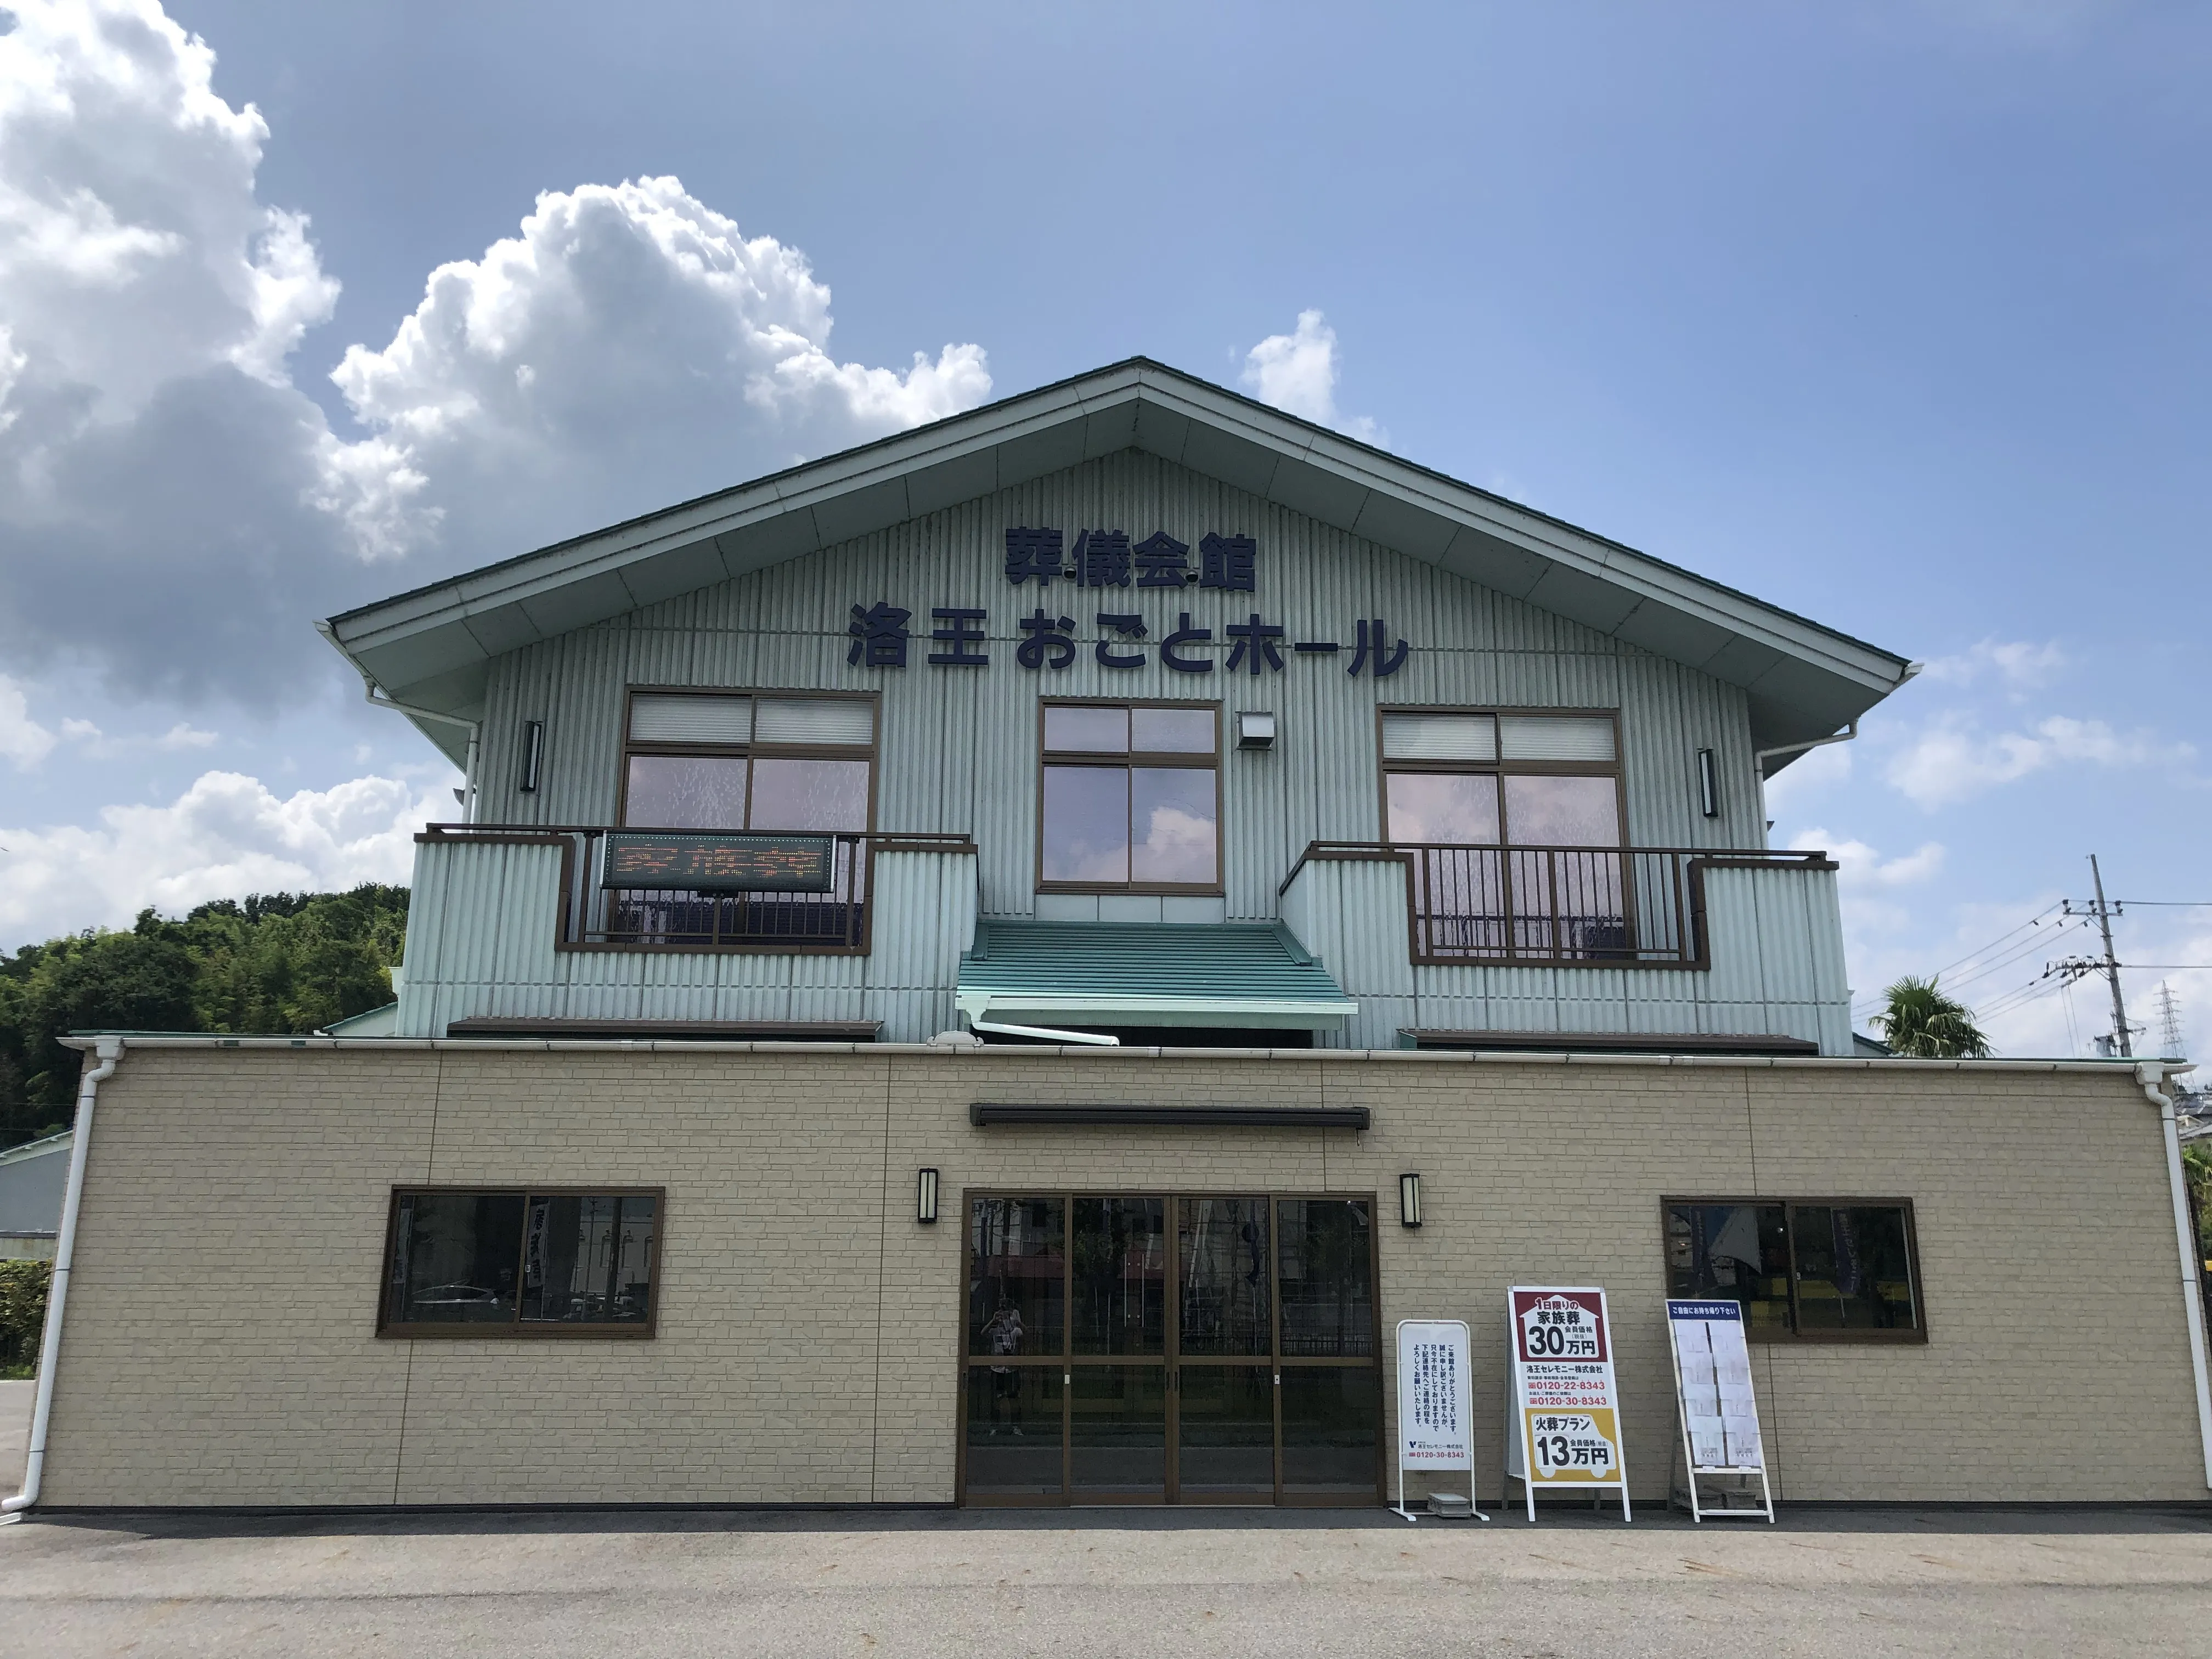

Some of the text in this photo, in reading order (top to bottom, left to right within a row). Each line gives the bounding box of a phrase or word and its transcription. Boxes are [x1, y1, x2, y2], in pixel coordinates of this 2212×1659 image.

[1005, 527, 1257, 592] 葬儀会館
[848, 602, 1408, 676] 洛王おごとホール
[1536, 1298, 1579, 1310] 1日限りの
[1672, 1307, 1736, 1315] ご自由にお持ち帰り下さい
[1537, 1311, 1581, 1325] 家族葬
[1526, 1365, 1603, 1373] 洛王セレモニー株式会社
[1431, 1345, 1439, 1431] 只今不在にしておりますので
[1537, 1381, 1605, 1390] 0120-22-8343
[1538, 1397, 1607, 1406] 0120-30-8343
[1536, 1417, 1590, 1431] 火葬プラン
